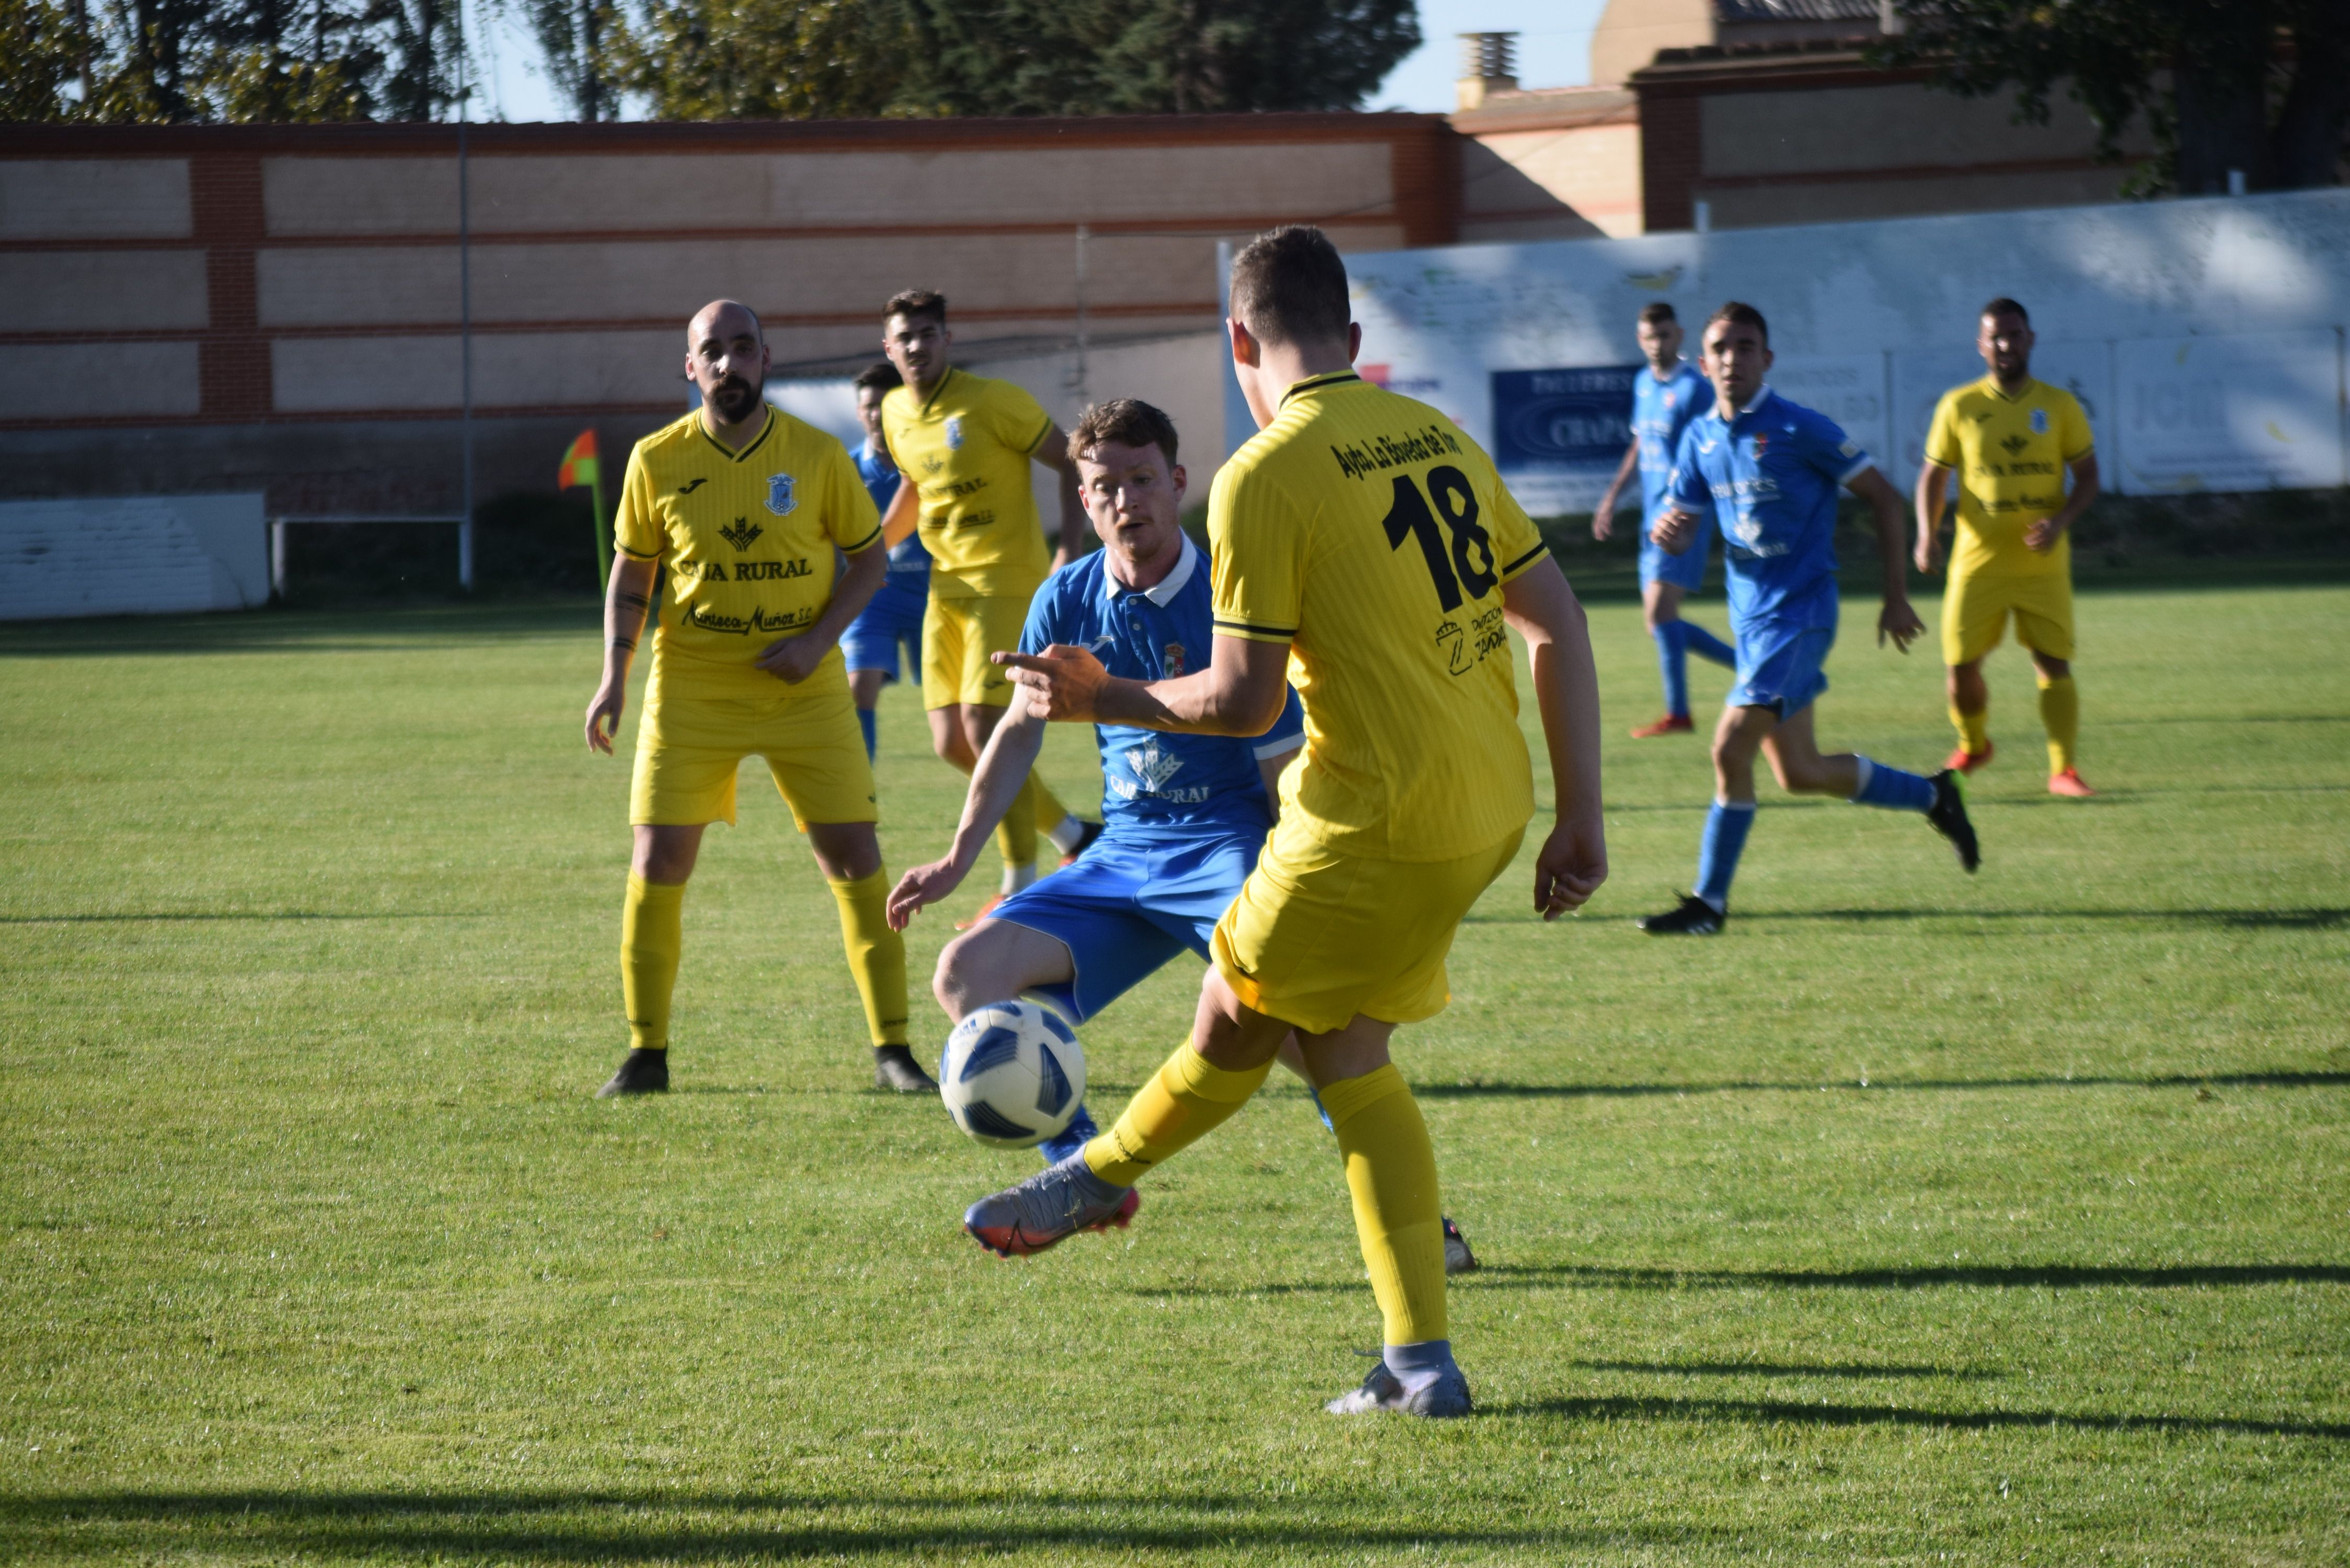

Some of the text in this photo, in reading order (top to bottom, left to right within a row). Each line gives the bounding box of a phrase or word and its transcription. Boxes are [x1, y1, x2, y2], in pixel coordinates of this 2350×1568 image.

[1361, 440, 1393, 468] La
[1419, 428, 1446, 456] de
[1382, 465, 1499, 614] 18
[734, 559, 812, 582] RURAL
[1147, 787, 1209, 803] URAL
